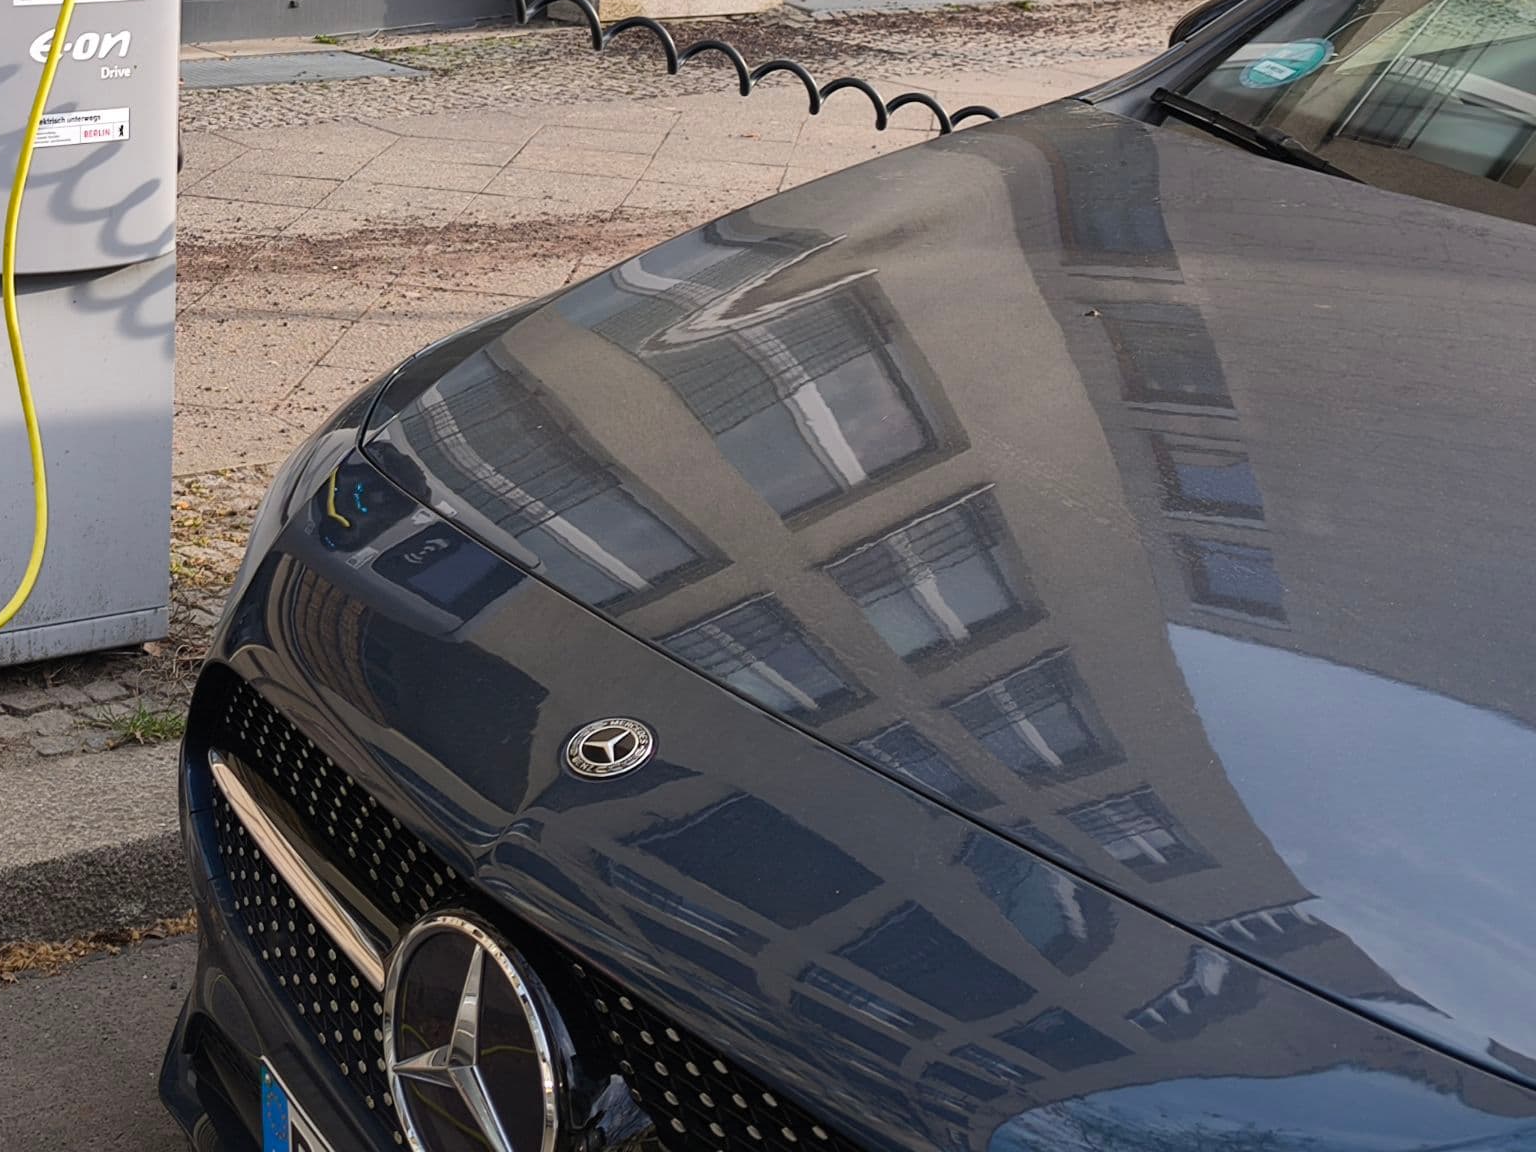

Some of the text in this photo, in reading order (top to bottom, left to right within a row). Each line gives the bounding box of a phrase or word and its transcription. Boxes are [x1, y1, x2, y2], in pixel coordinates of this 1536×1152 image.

[101, 66, 131, 80] Drive
[39, 115, 66, 126] ektrisch
[84, 128, 111, 138] BERLIN
